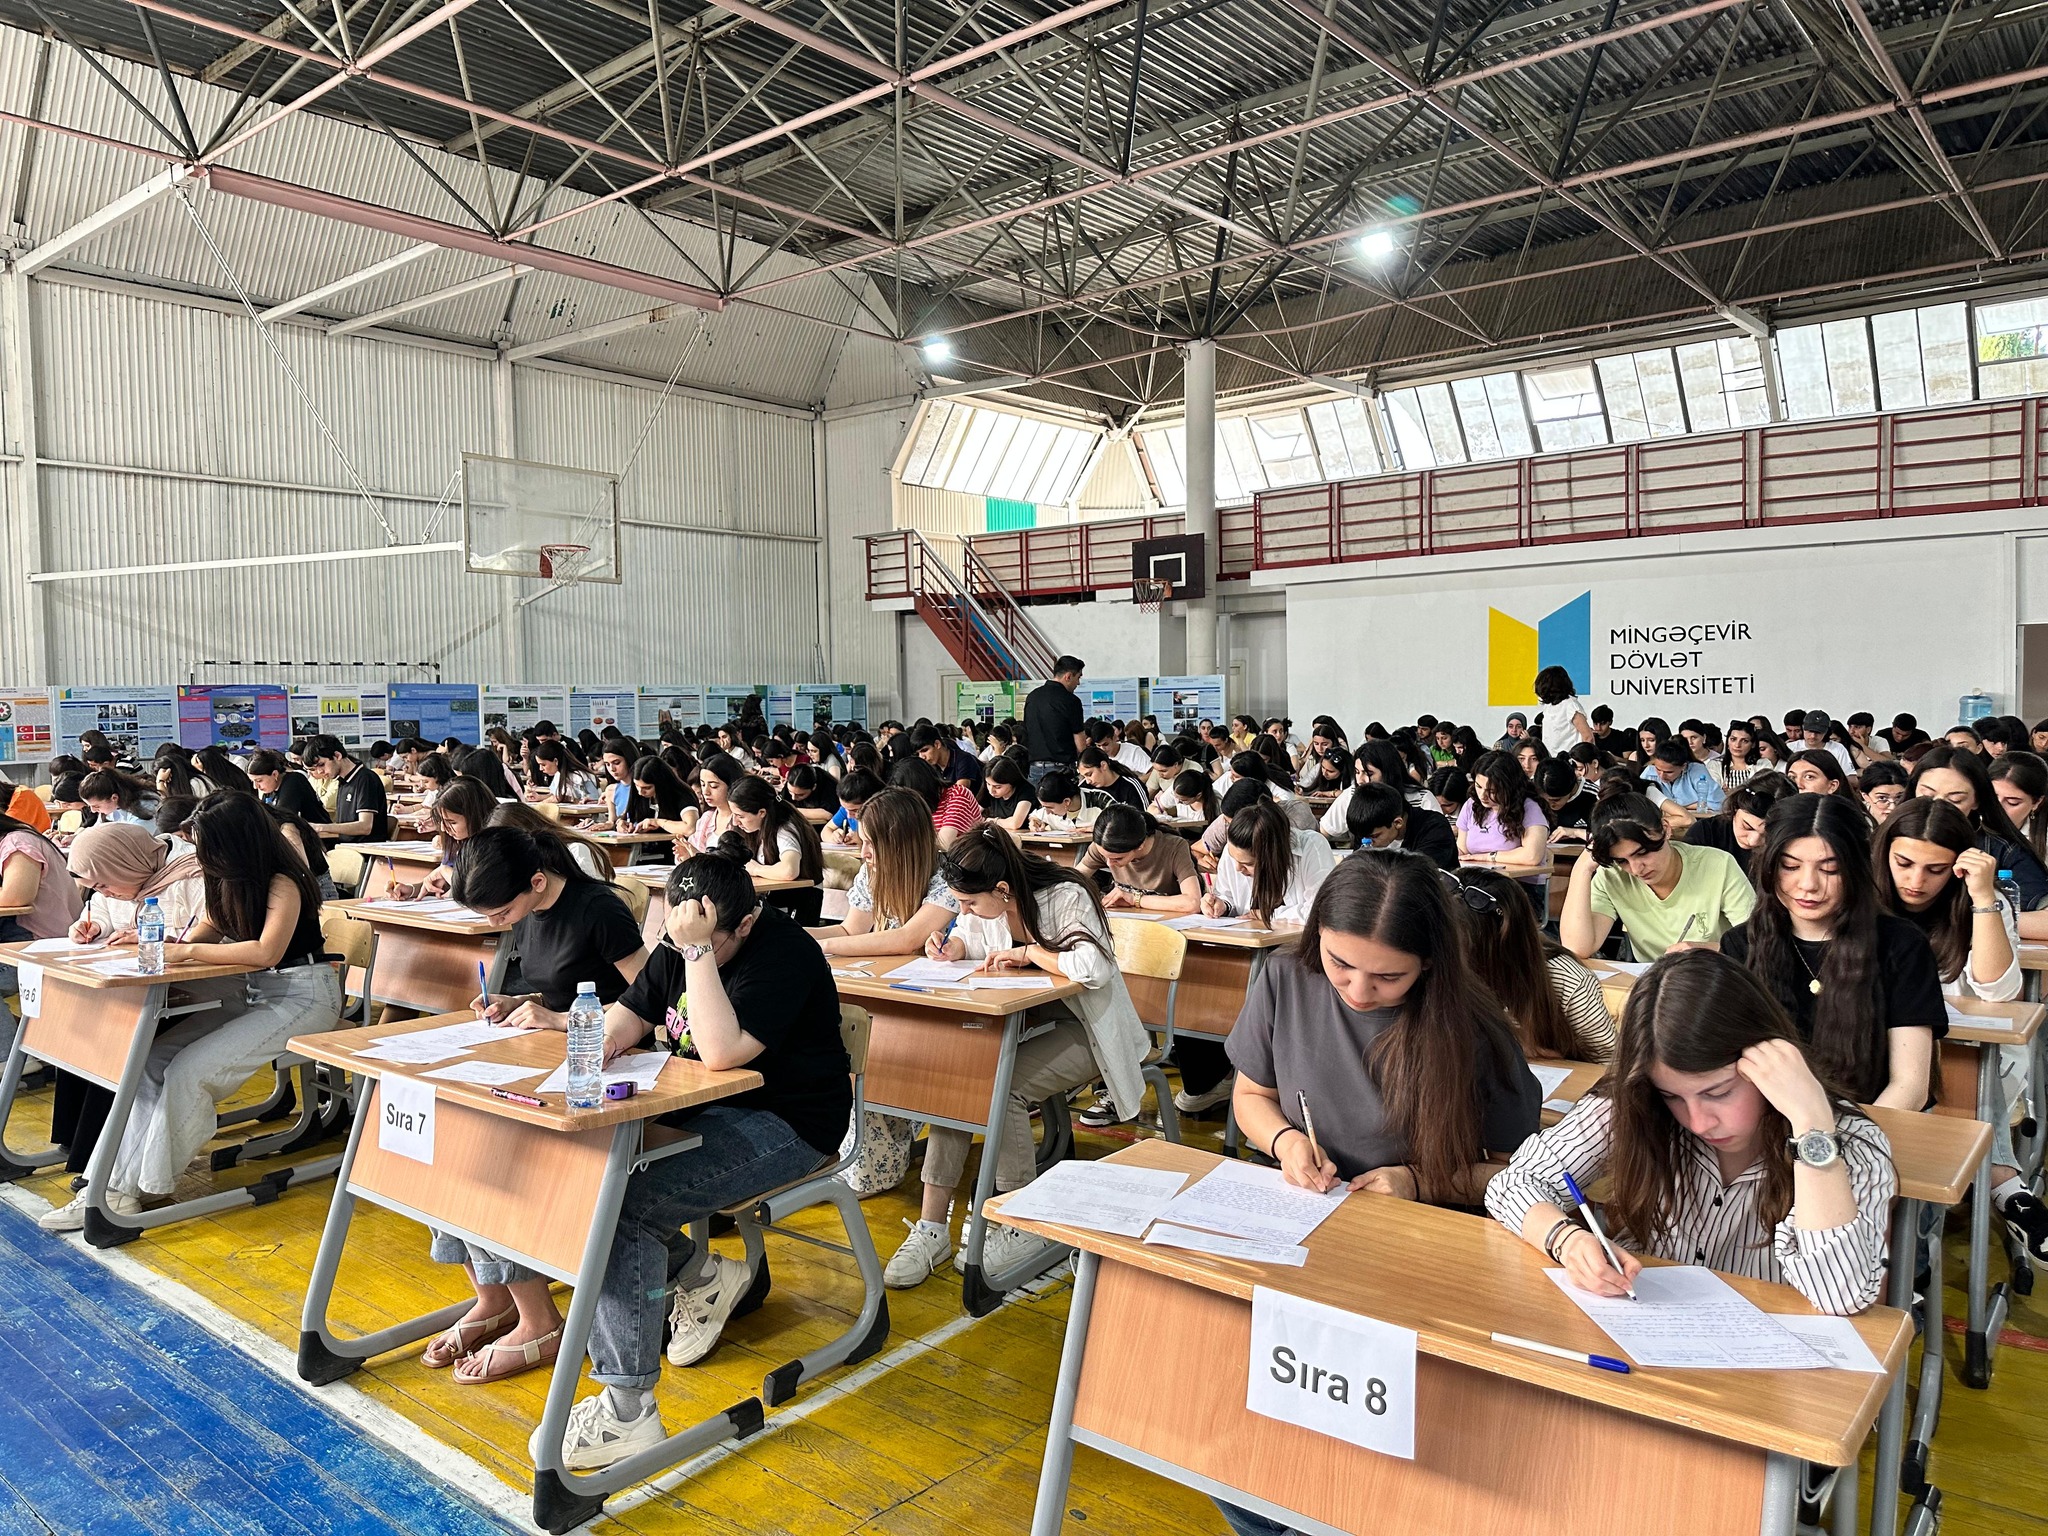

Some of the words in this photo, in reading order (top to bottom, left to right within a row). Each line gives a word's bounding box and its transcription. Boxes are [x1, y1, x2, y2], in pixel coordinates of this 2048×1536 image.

[1610, 620, 1752, 645] MİNGƏÇEVİR
[1610, 650, 1703, 669] DÖVLƏT
[1610, 674, 1754, 695] UNİVERSİTETİ
[31, 988, 37, 1003] 6
[386, 1102, 412, 1132] Sıra
[418, 1112, 426, 1135] 7
[1270, 1345, 1349, 1405] Sıra
[1364, 1377, 1387, 1416] 8
